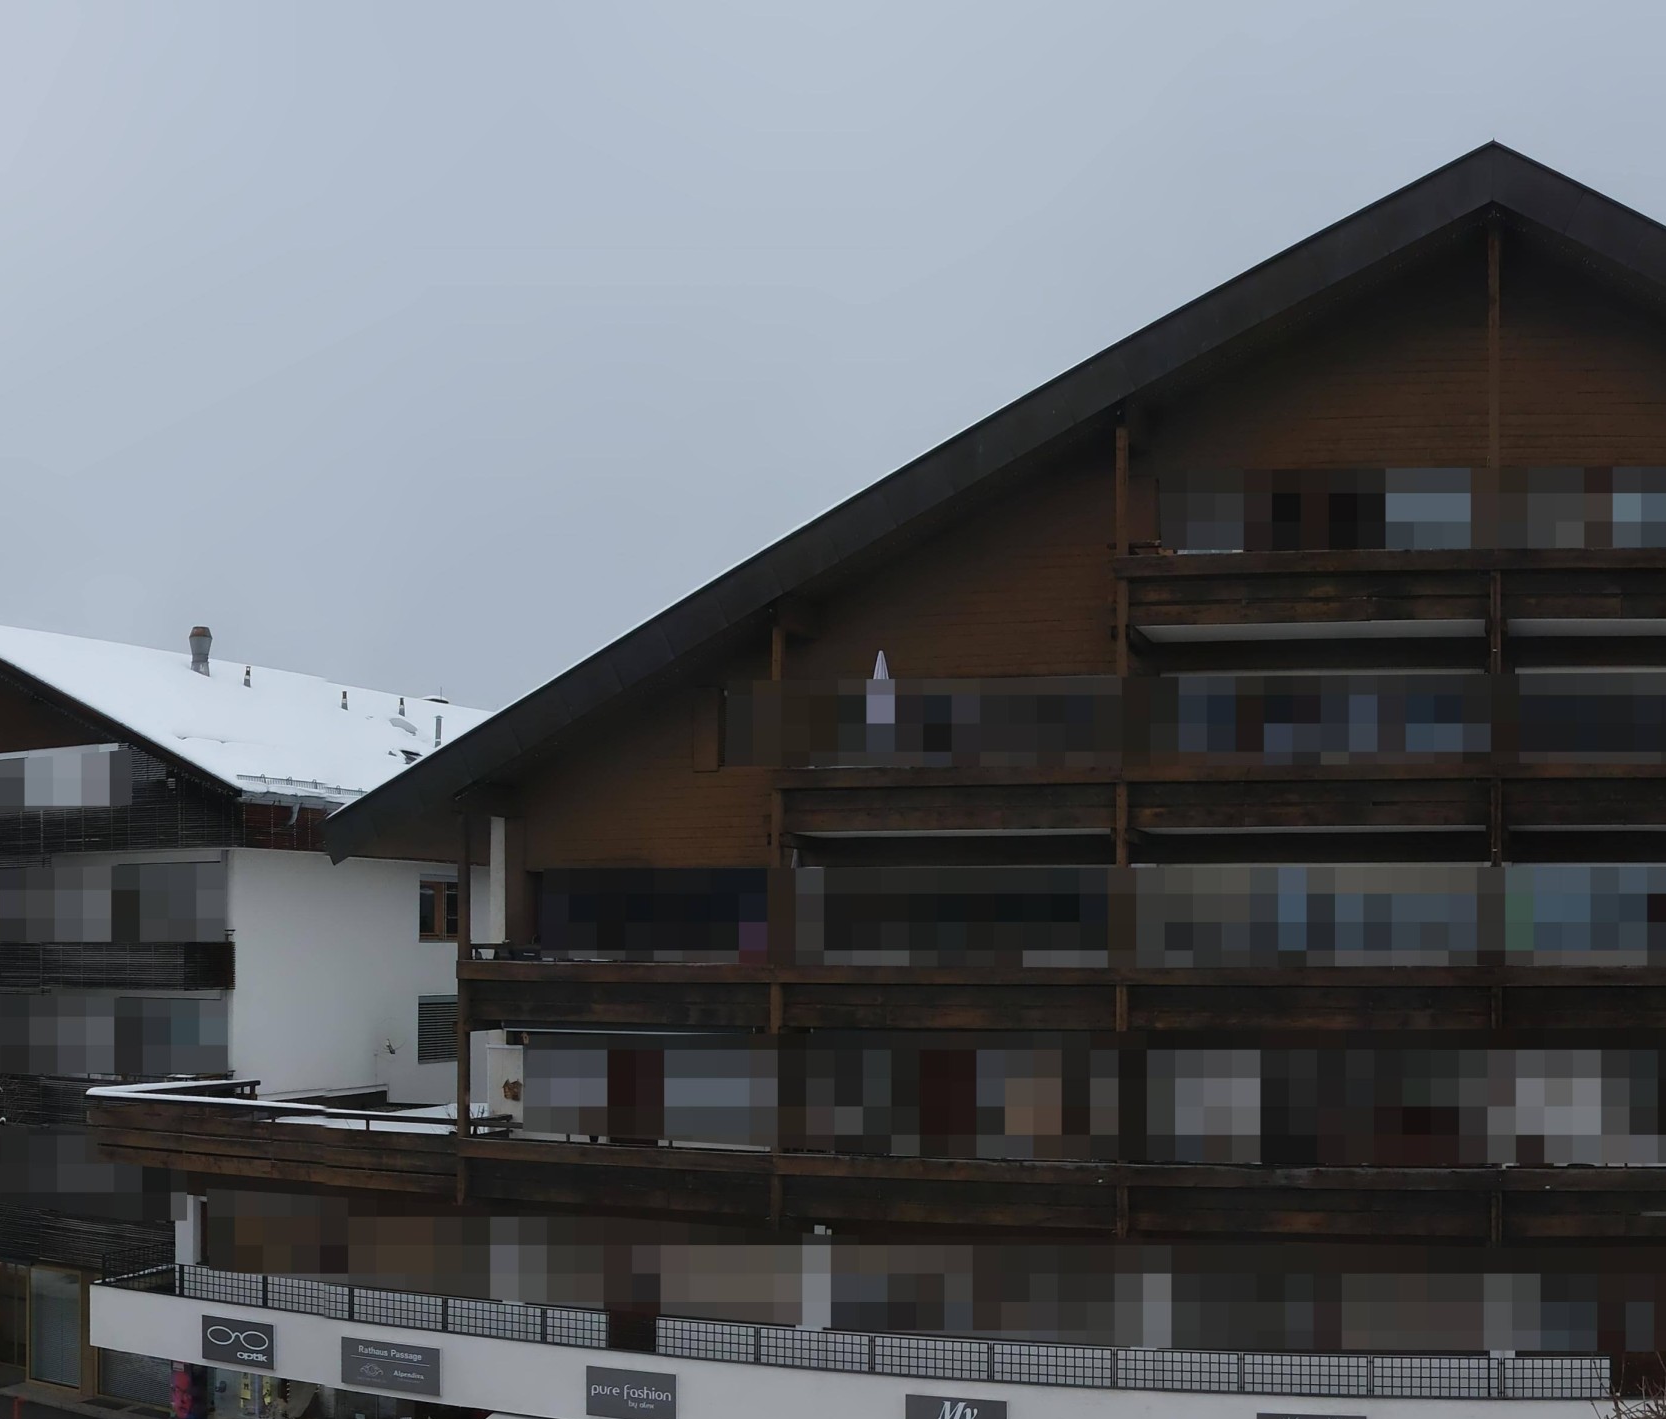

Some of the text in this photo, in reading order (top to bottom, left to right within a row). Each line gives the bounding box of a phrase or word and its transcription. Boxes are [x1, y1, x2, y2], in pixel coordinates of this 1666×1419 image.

[237, 1351, 268, 1363] optik
[358, 1345, 422, 1362] Rathaus Passage
[591, 1384, 671, 1402] pure fashion
